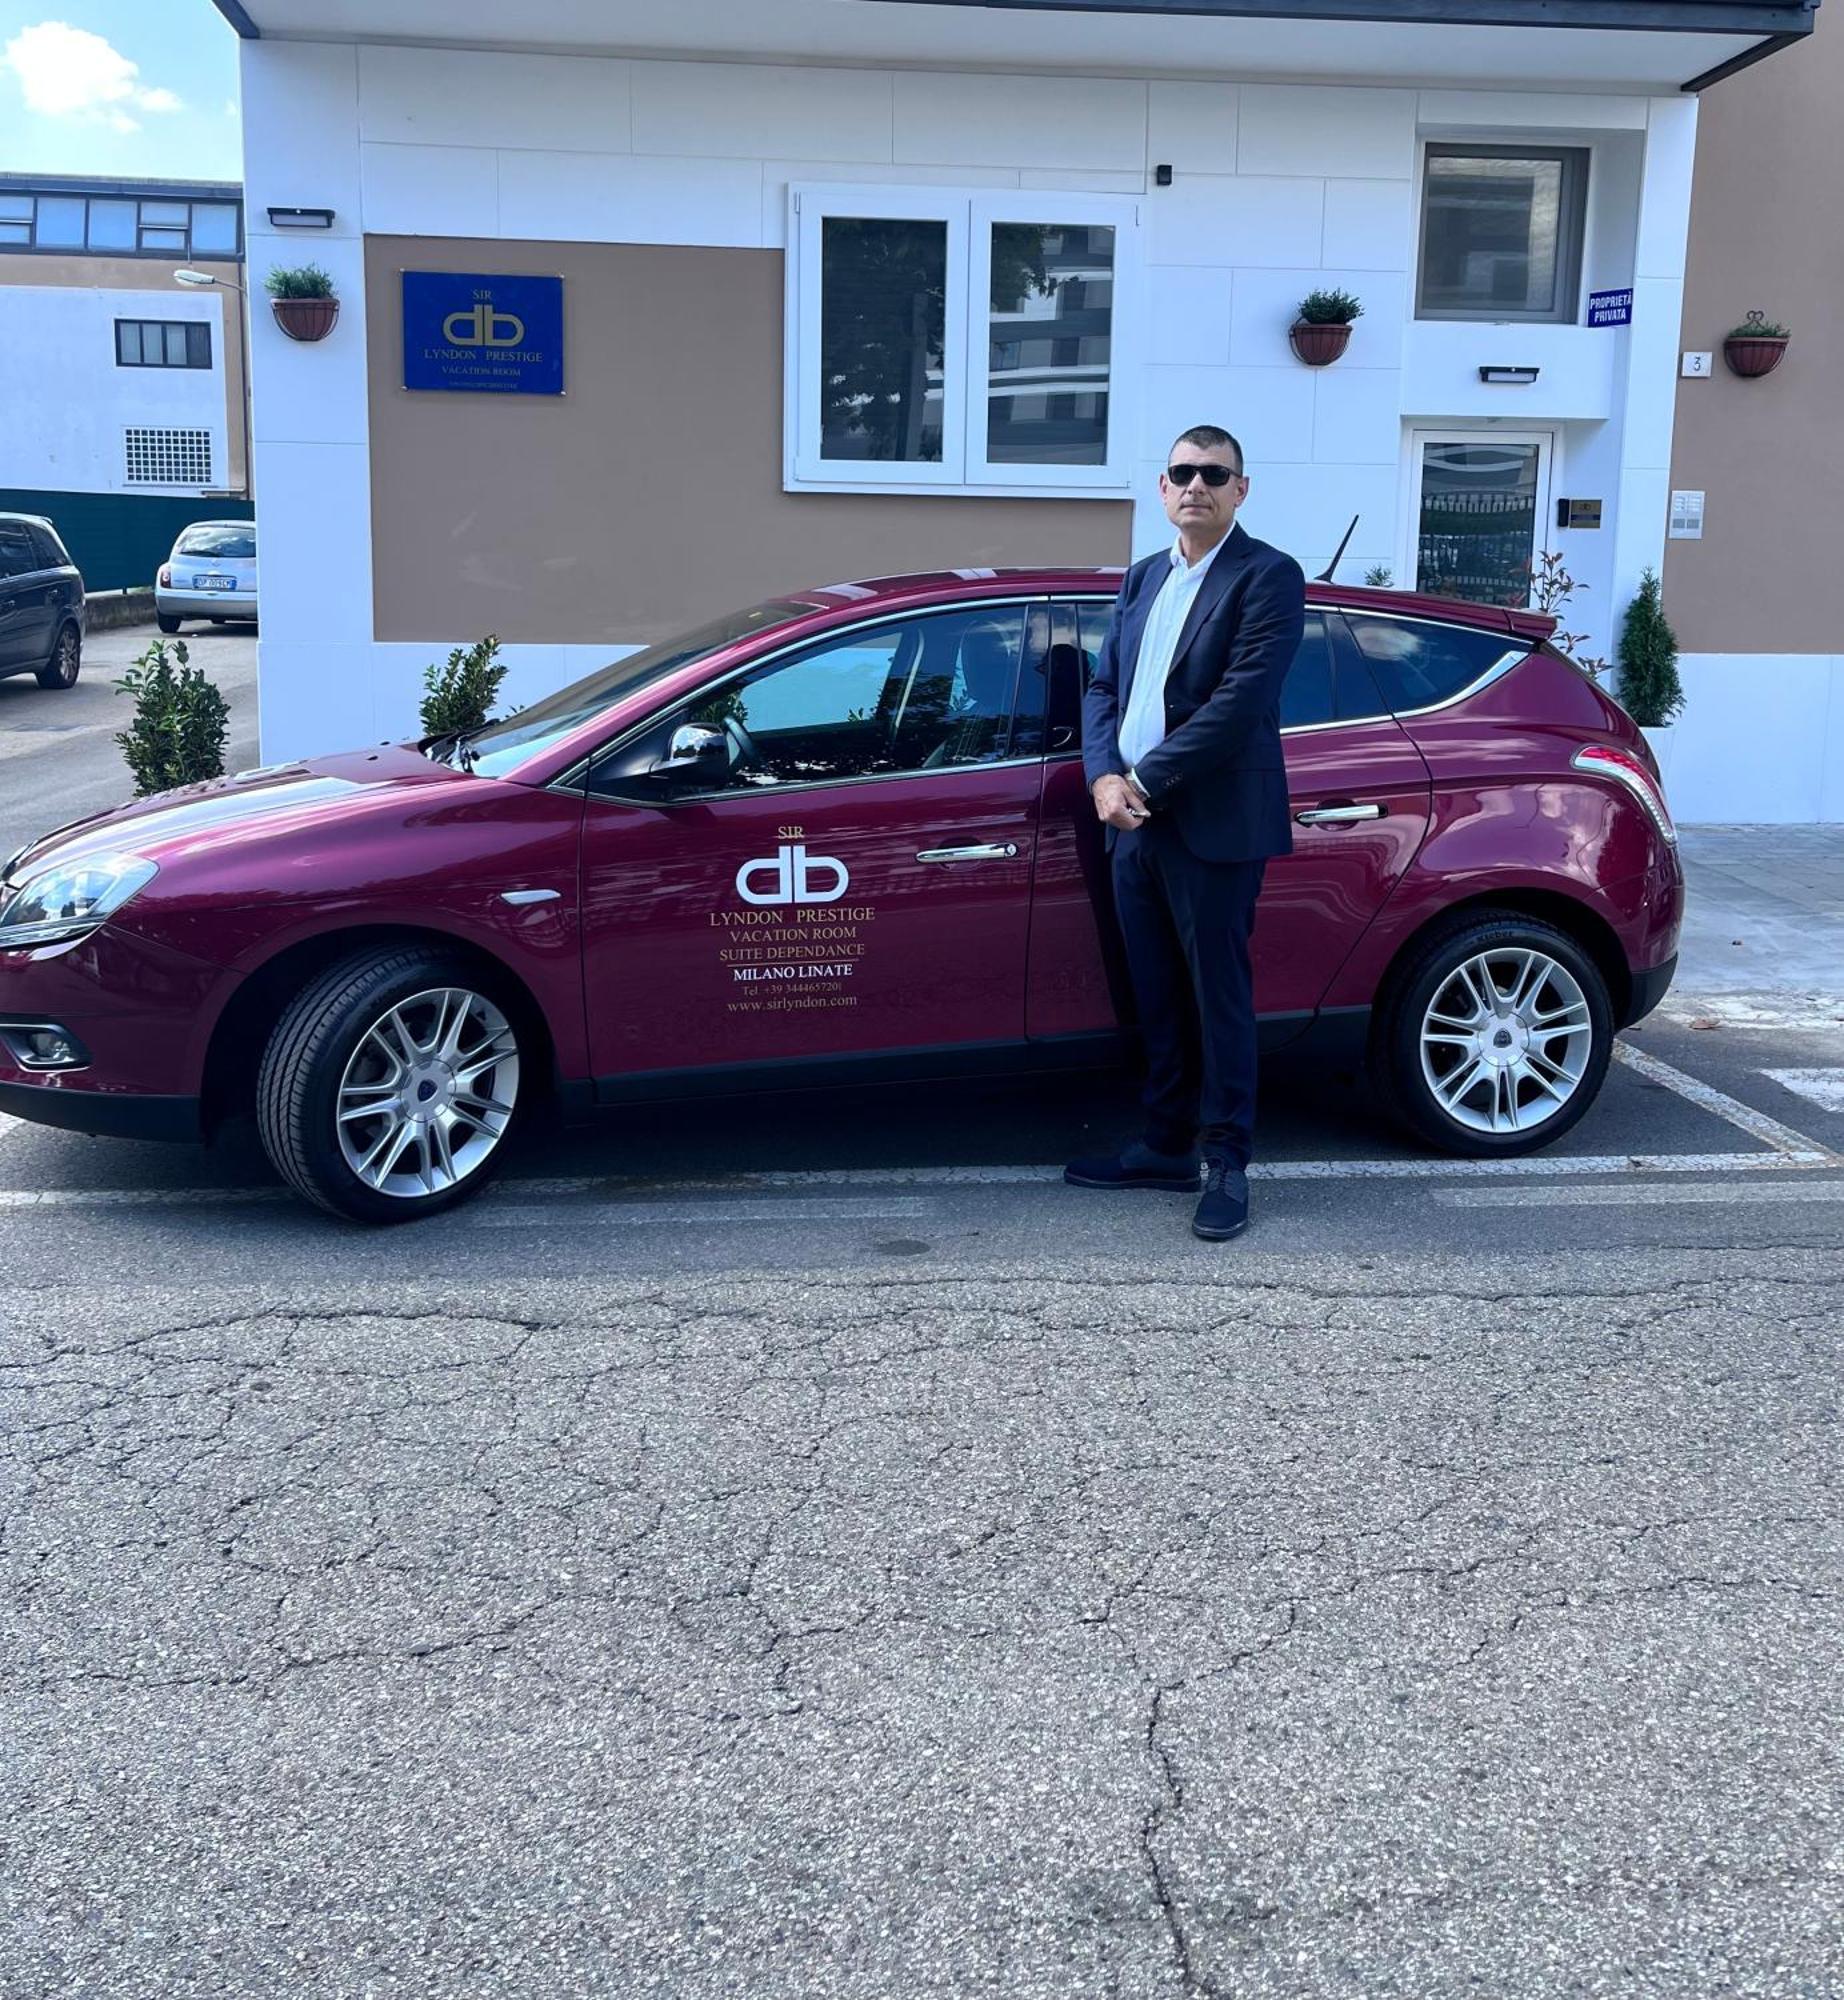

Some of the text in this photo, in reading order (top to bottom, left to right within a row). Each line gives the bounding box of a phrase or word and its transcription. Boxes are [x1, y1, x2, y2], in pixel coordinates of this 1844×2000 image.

[472, 289, 492, 300] SIR
[1594, 309, 1626, 323] PRIVATA
[424, 349, 543, 362] LYNDON PRESTIGE
[1694, 356, 1701, 371] 3
[442, 366, 521, 377] VACATION ROOM
[778, 826, 804, 840] SIR
[736, 845, 849, 905] db
[710, 907, 876, 926] LYNDON PRESTIGE
[730, 926, 857, 943] VACATION ROOM
[719, 943, 865, 961] SUITE DEPENDANCE
[733, 963, 853, 982] MILANO LINATE
[727, 994, 858, 1013] www.sirlyndon.com
